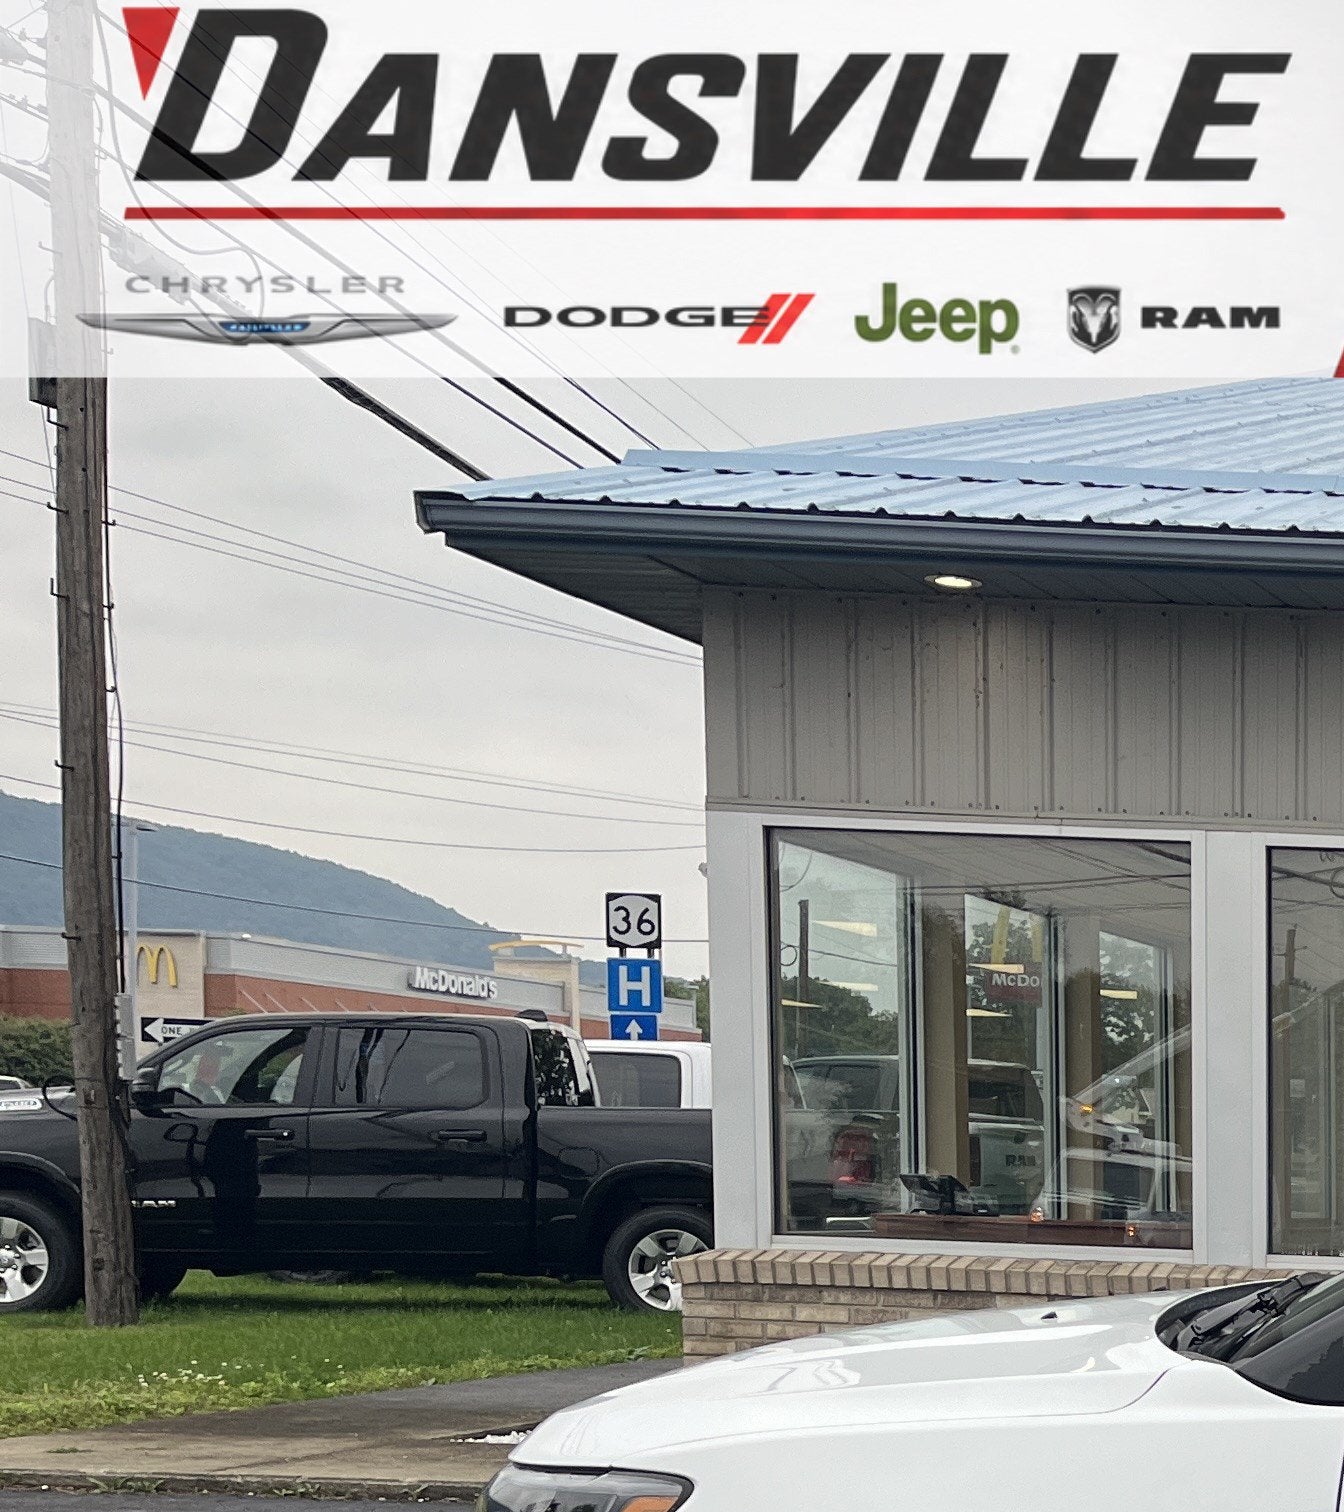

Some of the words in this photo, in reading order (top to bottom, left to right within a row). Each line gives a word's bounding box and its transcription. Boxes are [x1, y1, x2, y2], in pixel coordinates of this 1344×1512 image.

[612, 905, 656, 936] 36
[413, 965, 499, 1000] McDonald's
[618, 965, 651, 1007] H
[161, 1026, 182, 1036] ONE
